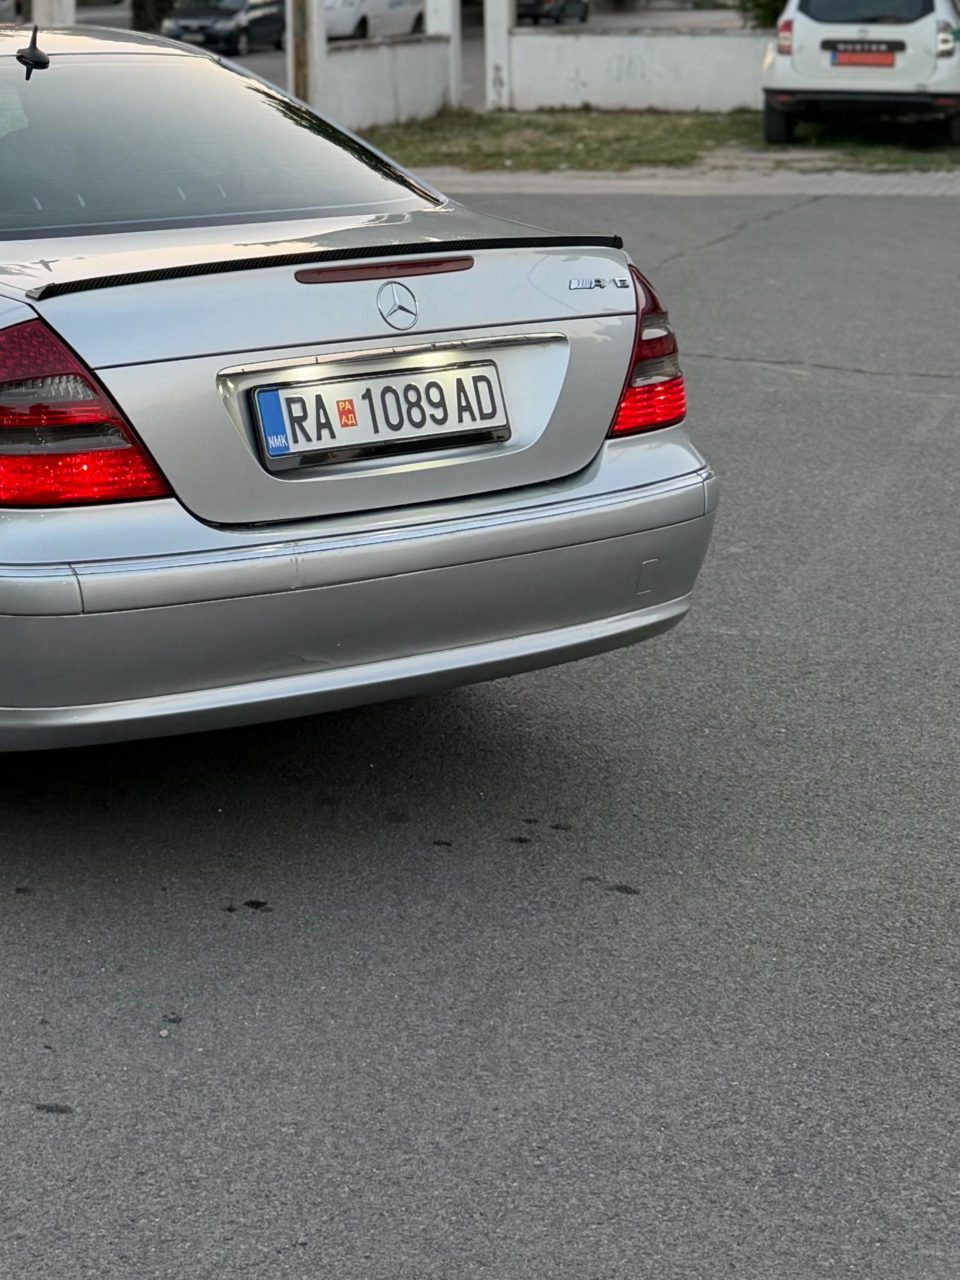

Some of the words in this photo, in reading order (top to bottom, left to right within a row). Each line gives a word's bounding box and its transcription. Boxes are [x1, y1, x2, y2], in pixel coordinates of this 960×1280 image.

[284, 393, 337, 444] RA
[361, 380, 449, 434] 1089
[455, 374, 498, 424] AD
[267, 434, 289, 449] NMK
